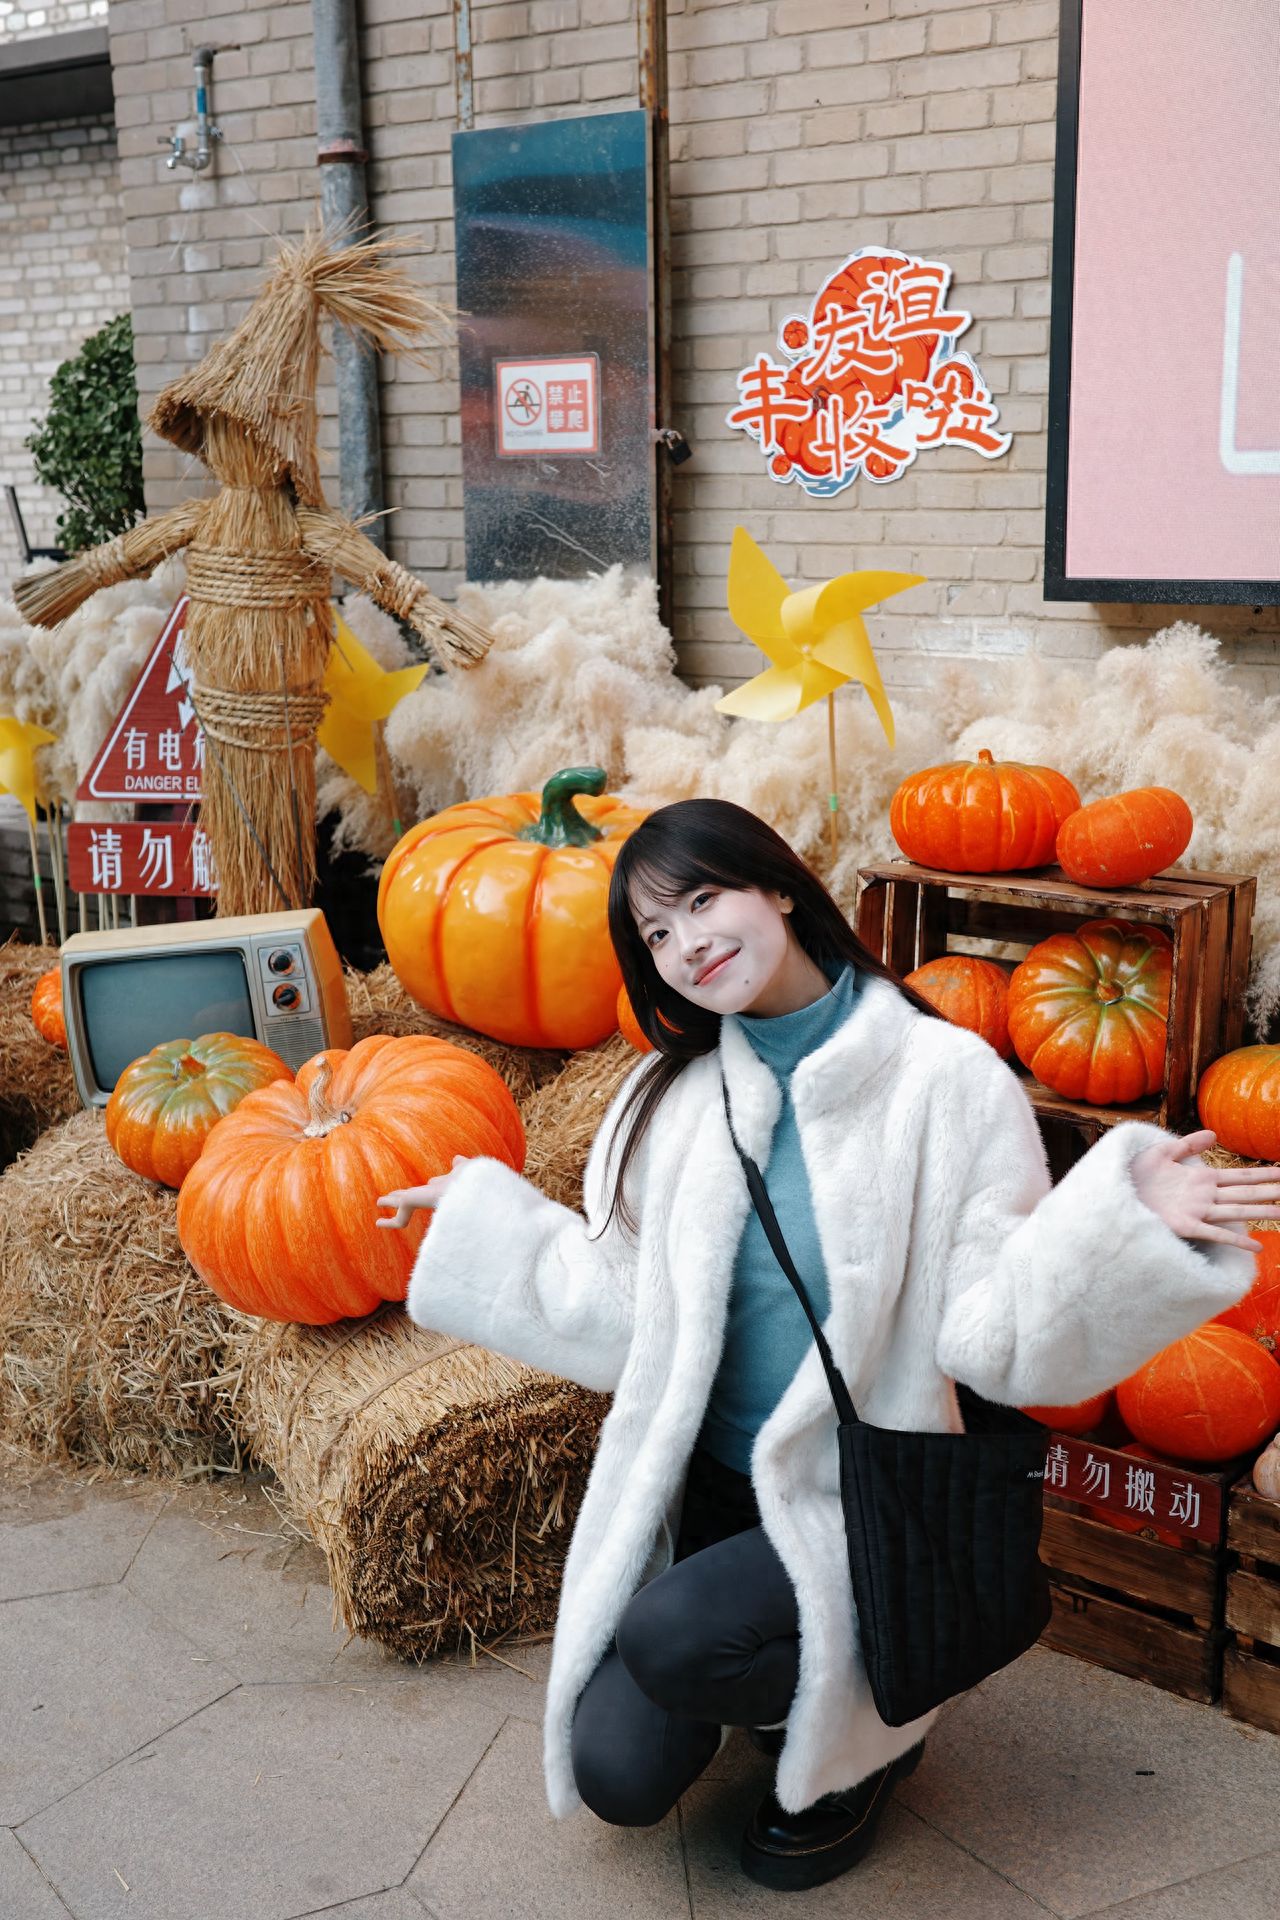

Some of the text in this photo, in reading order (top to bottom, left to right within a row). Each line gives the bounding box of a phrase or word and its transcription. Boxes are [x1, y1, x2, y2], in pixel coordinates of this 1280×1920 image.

[804, 263, 971, 383] 友谊
[548, 384, 584, 405] 禁止
[730, 358, 1006, 479] 丰收啦
[124, 775, 182, 791] DANGER
[1043, 1443, 1200, 1528] 请勿搬动
